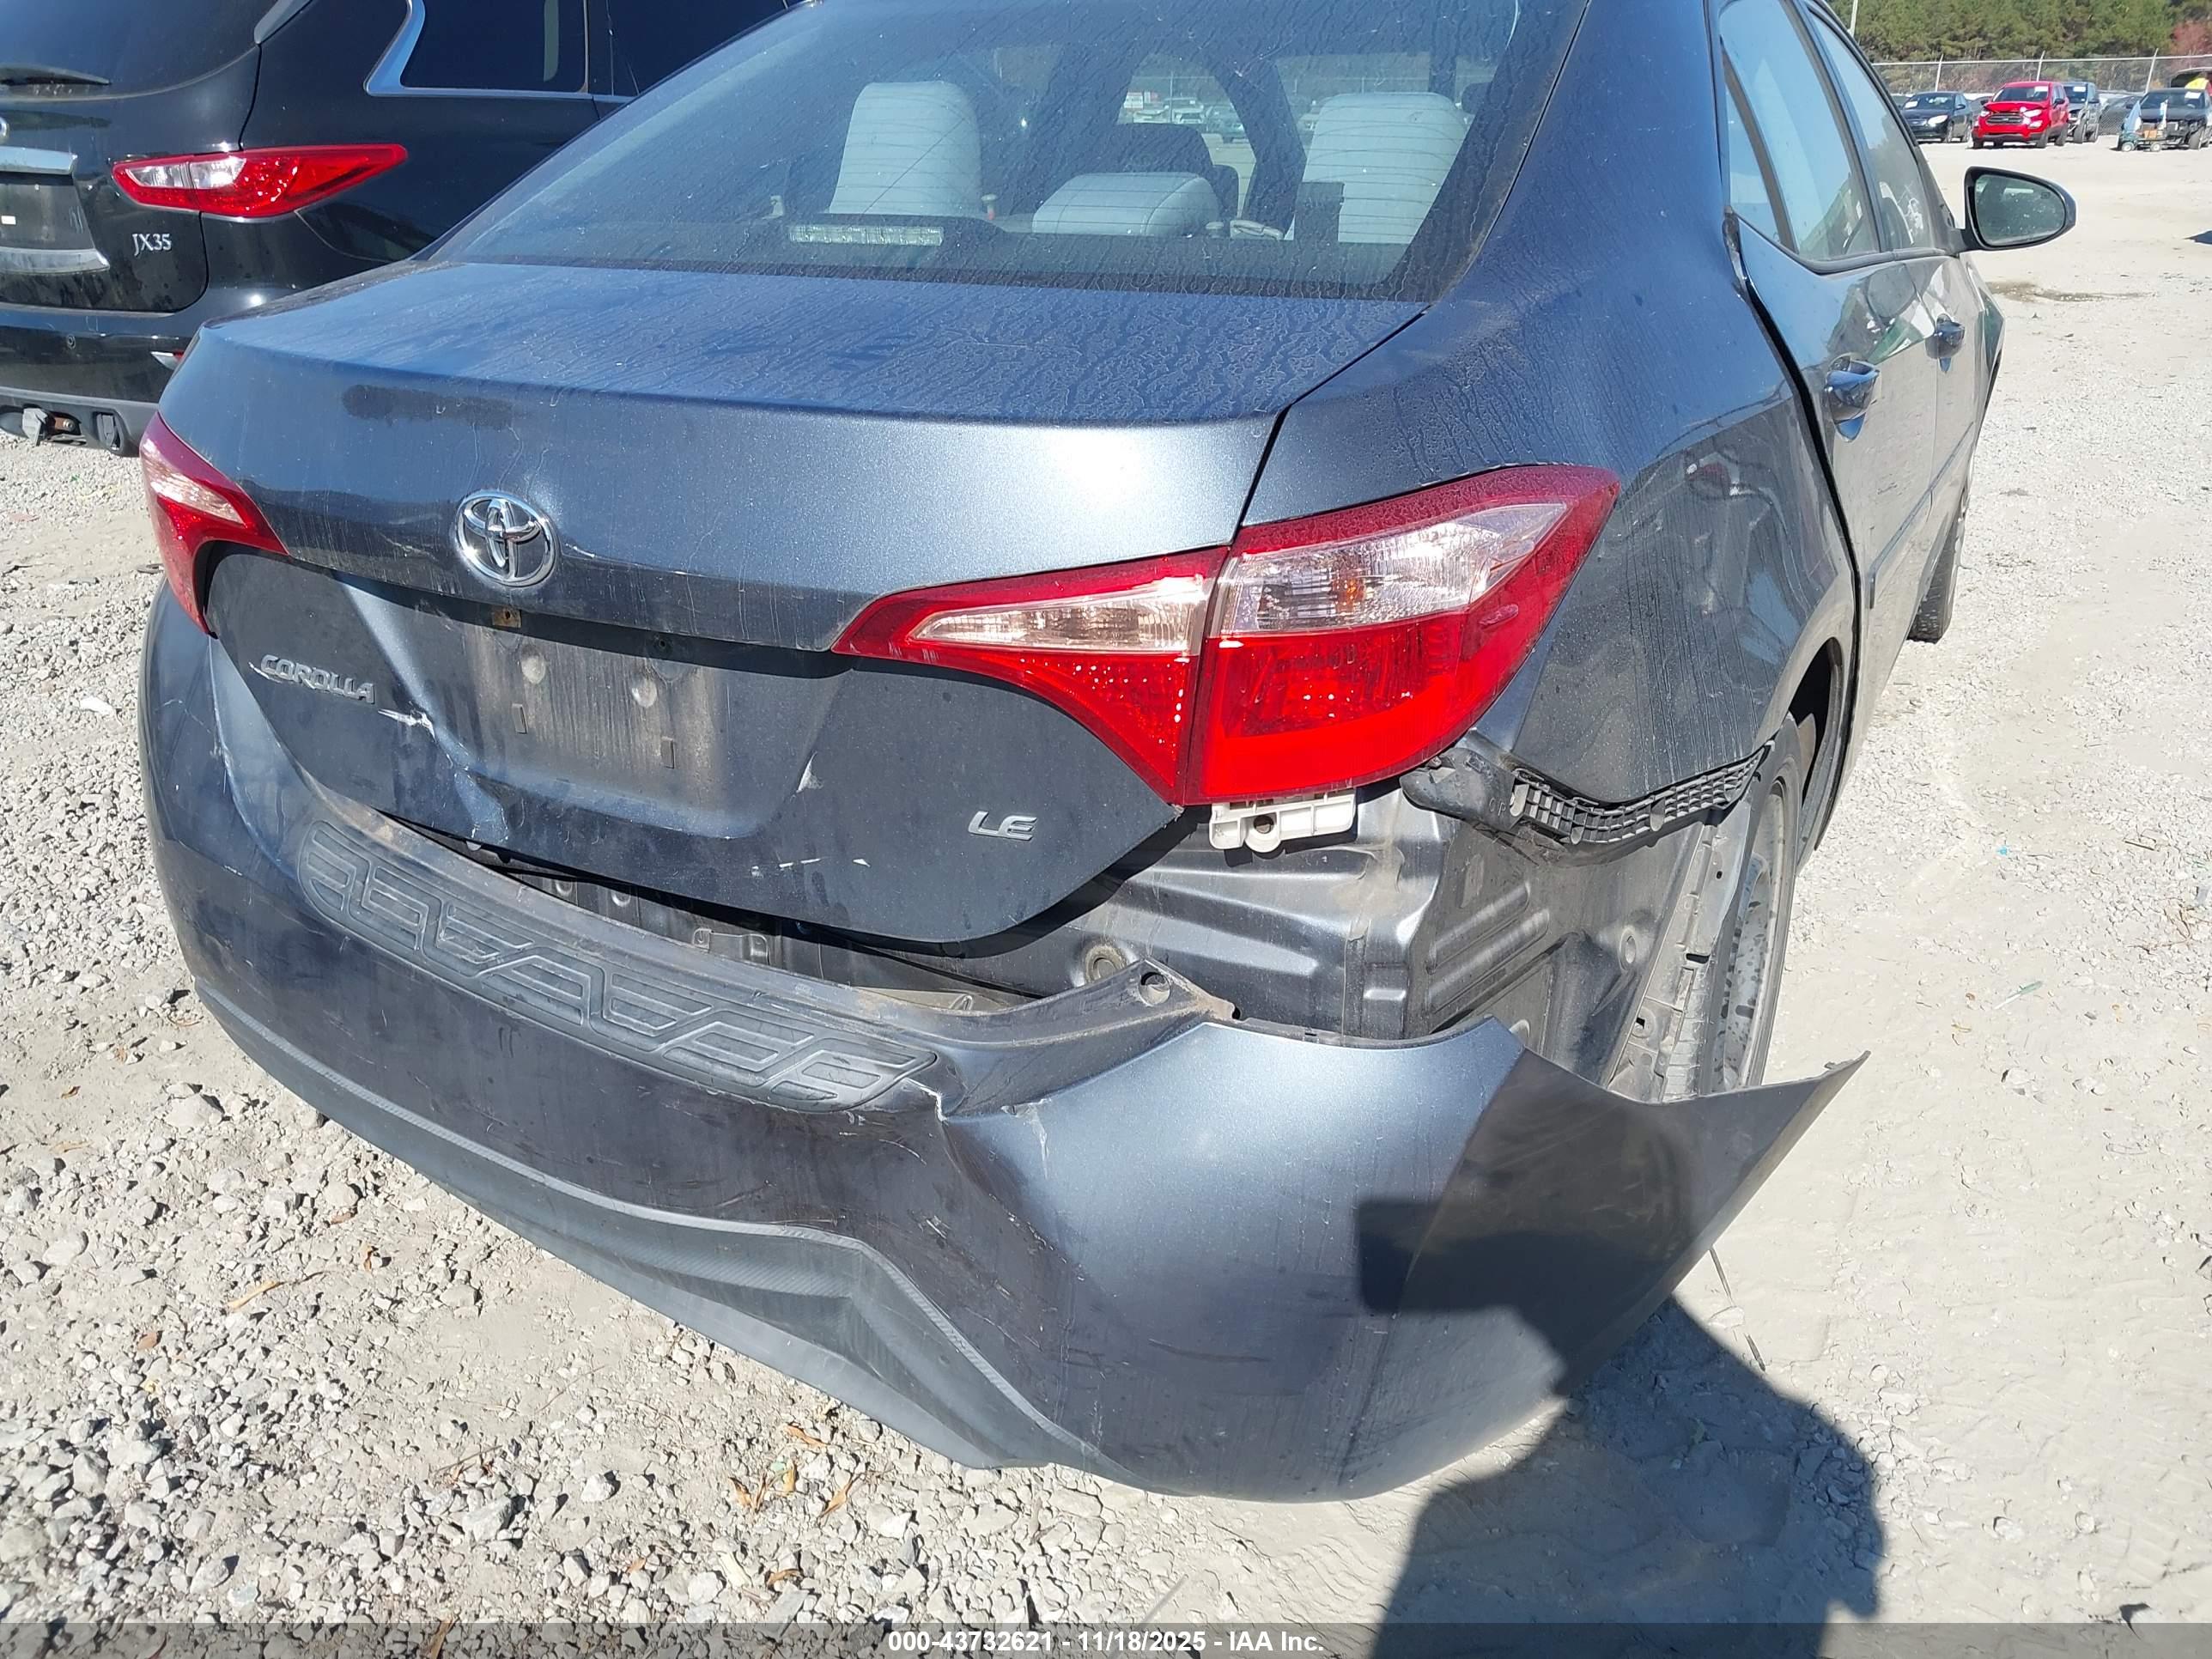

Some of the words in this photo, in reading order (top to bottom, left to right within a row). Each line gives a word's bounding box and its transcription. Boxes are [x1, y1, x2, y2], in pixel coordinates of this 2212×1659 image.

[131, 233, 172, 257] JX35
[260, 653, 375, 705] COROLLA
[968, 810, 1037, 841] LE
